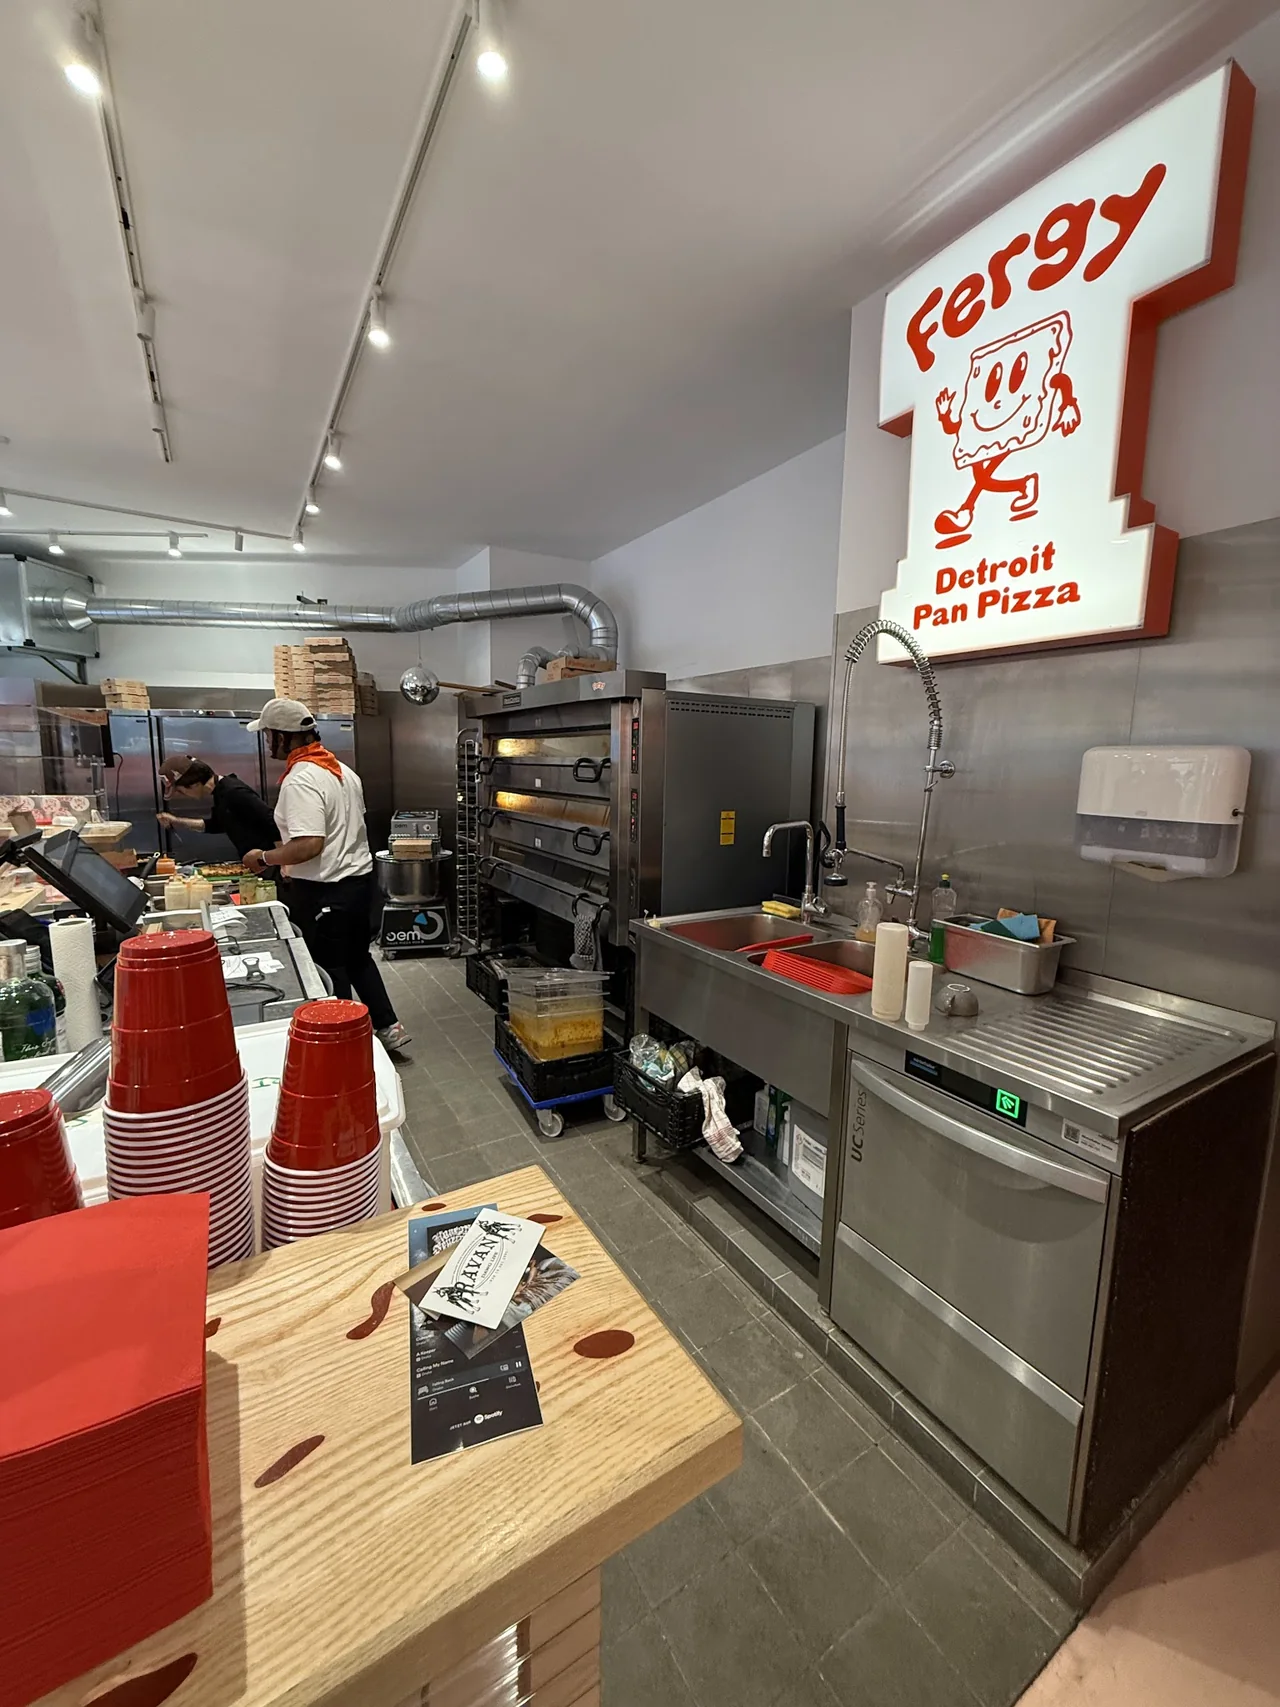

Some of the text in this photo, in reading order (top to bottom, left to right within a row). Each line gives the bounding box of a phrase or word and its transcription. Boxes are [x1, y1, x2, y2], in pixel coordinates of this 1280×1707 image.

[935, 541, 1057, 595] Detroit
[913, 581, 1081, 630] Pan Pizza
[386, 931, 421, 942] oem
[484, 1410, 503, 1420] Spotify
